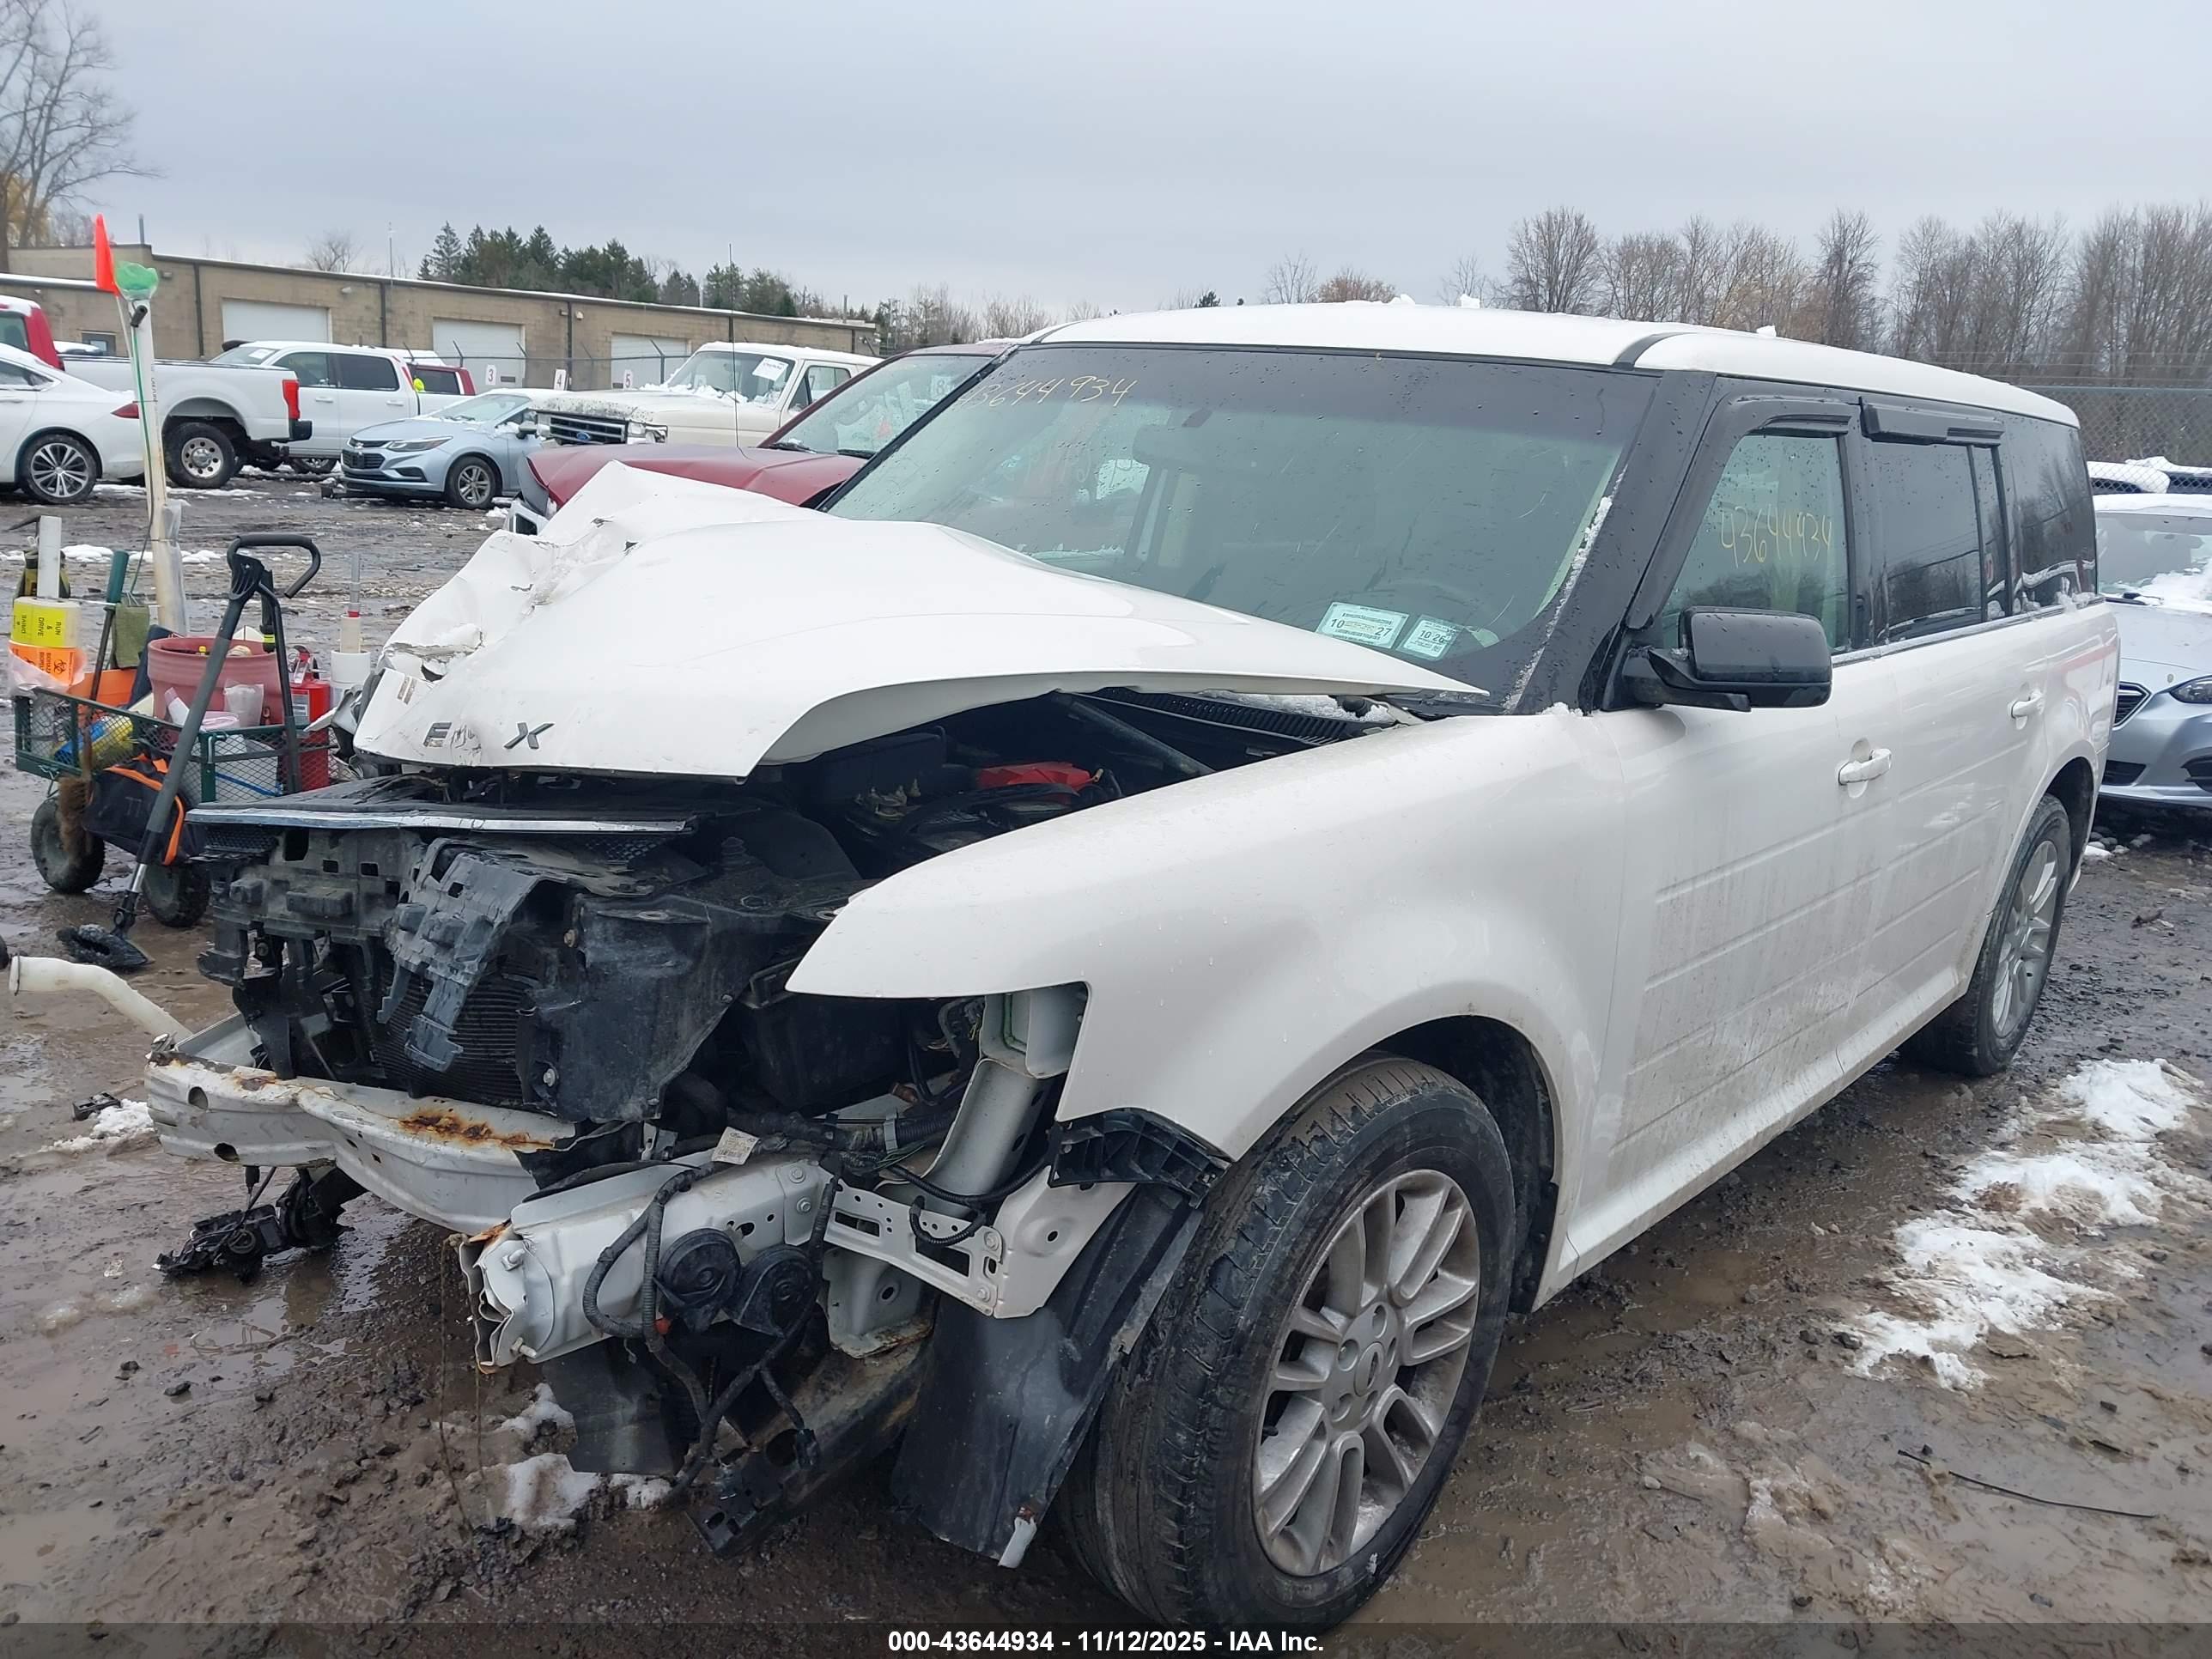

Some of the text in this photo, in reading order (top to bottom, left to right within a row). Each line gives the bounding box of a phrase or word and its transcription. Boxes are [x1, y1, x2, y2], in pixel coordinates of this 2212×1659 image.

[488, 368, 494, 382] 3
[625, 374, 631, 388] 5
[1330, 618, 1346, 629] 10
[1374, 627, 1393, 637] 27
[1419, 630, 1432, 639] 10
